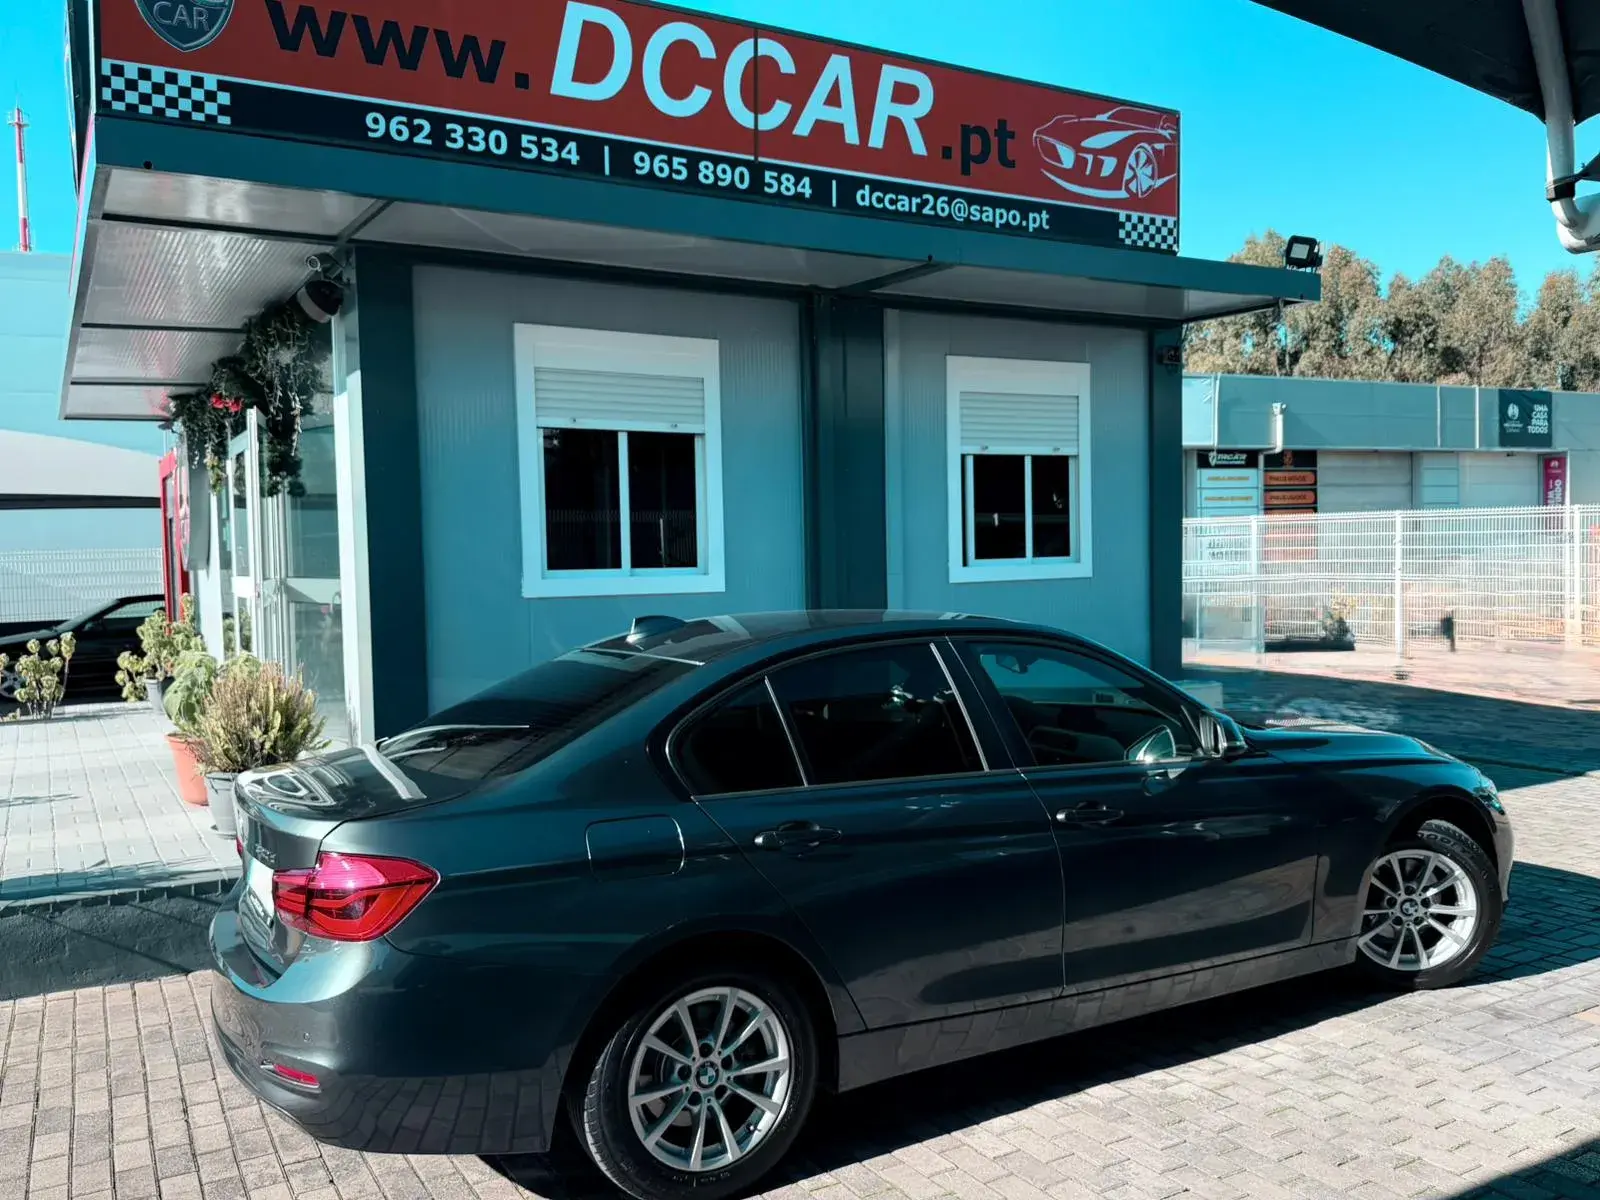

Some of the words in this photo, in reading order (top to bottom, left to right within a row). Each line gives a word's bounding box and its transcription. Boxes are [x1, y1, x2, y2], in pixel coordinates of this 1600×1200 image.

[153, 1, 210, 31] CAR
[365, 111, 433, 145] 962
[445, 123, 508, 155] 330
[520, 134, 580, 166] 534
[633, 151, 688, 181] 965
[698, 160, 750, 190] 890
[763, 170, 813, 199] 584
[855, 185, 1050, 233] dccar26@sapo.pt
[1527, 426, 1548, 434] TODOS
